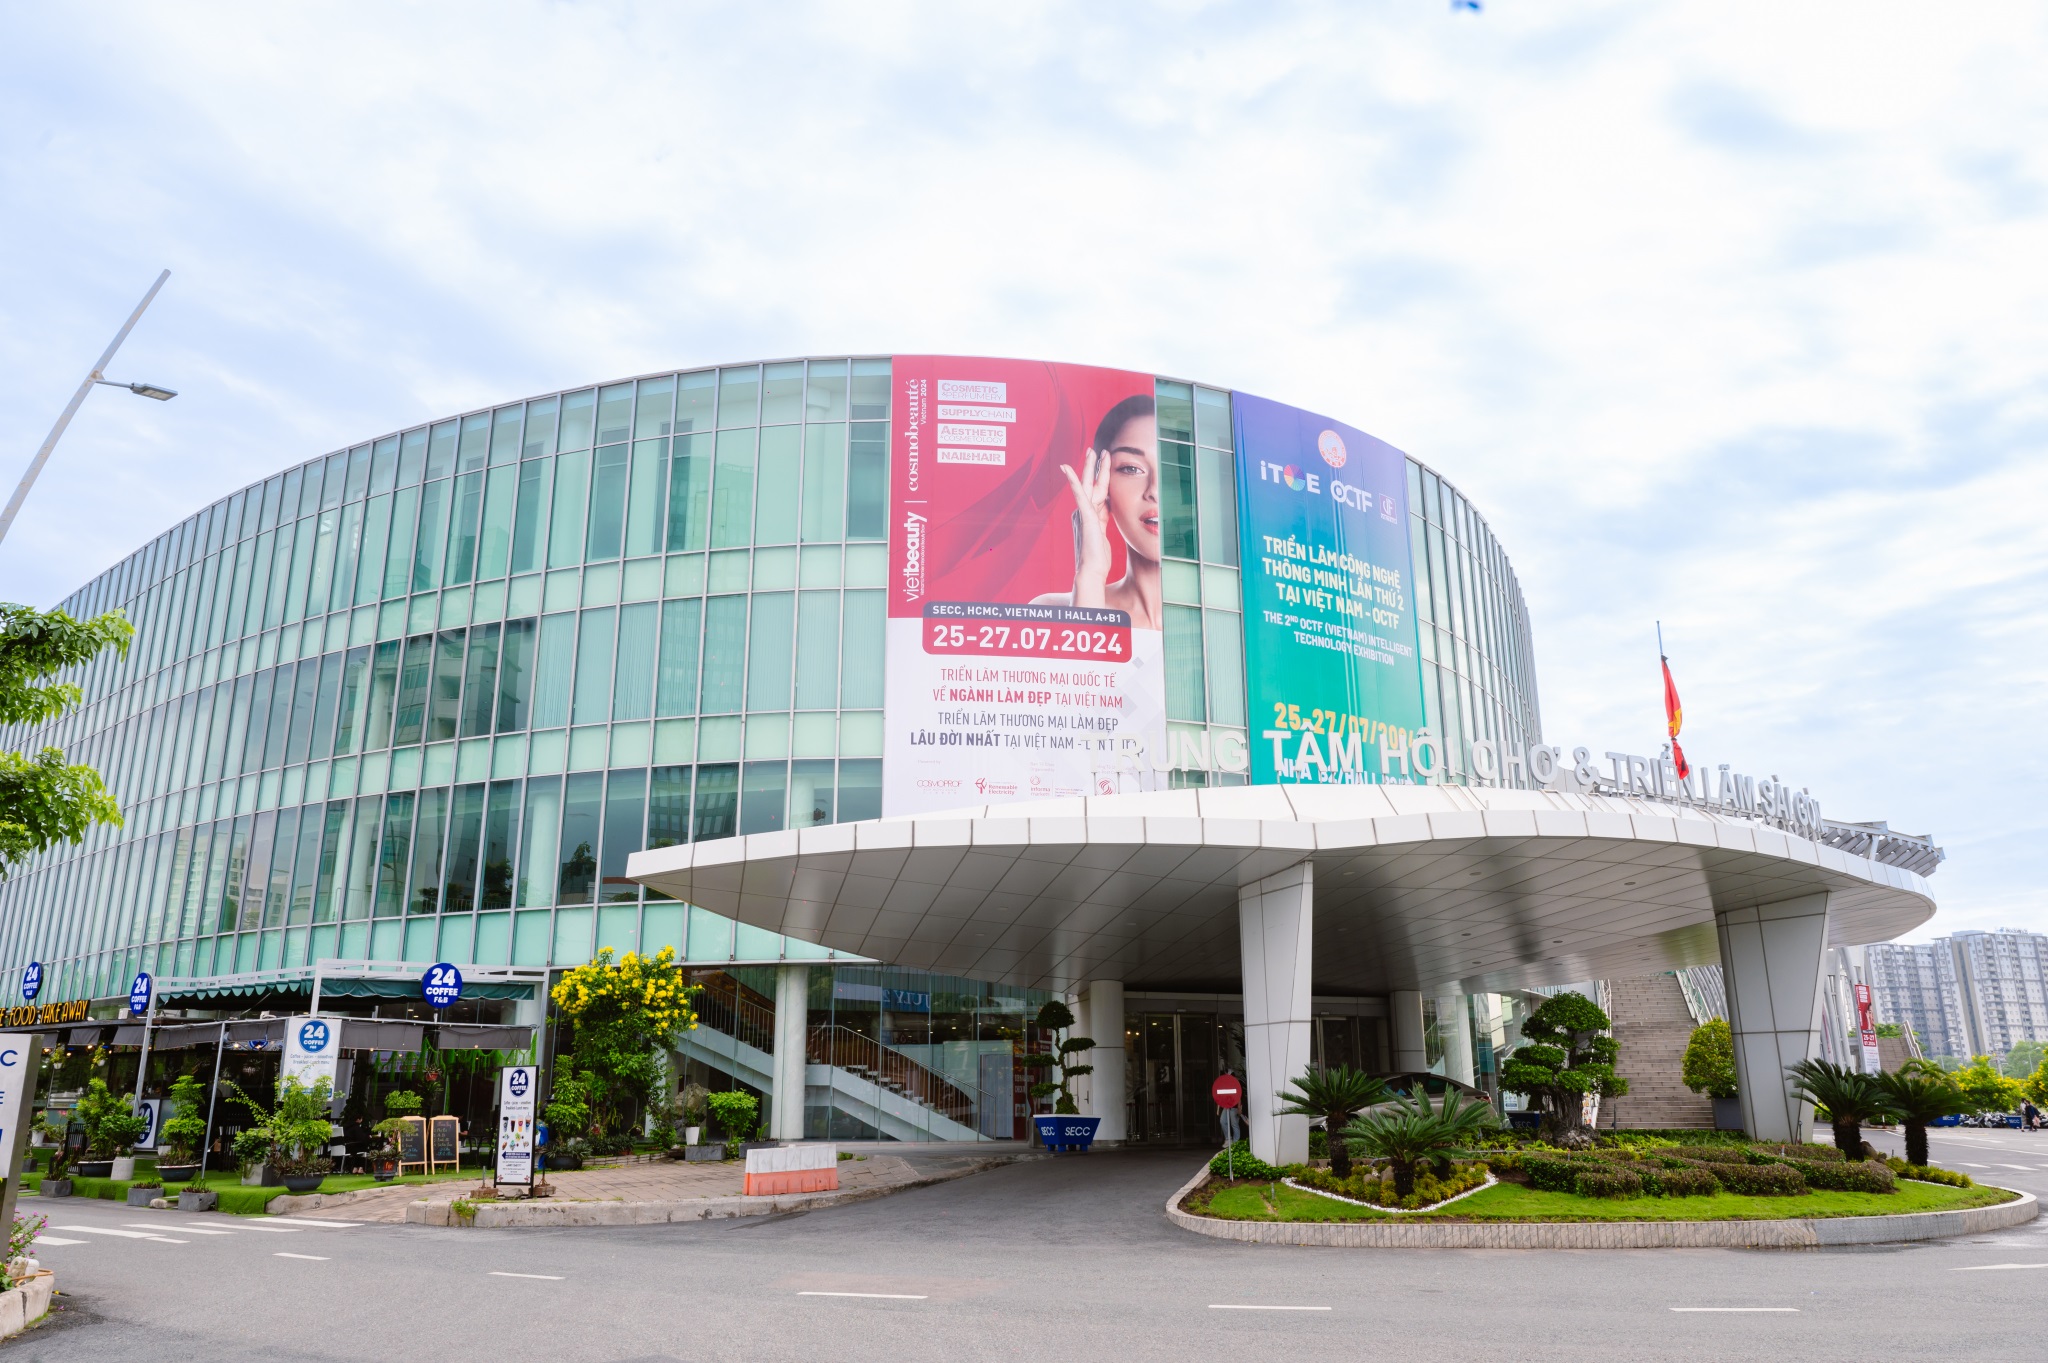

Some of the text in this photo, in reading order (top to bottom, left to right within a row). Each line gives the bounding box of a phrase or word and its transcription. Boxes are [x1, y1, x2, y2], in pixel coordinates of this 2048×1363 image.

[904, 378, 919, 491] cosmobeauté
[940, 425, 1004, 437] AESTHETIC
[903, 511, 928, 602] vietbeauty
[1263, 534, 1402, 590] TRIỂN LÃM CÔNG NGHỆ
[1262, 557, 1405, 611] THÔNG MINH LẦN THỨ 2
[932, 605, 965, 617] SECC,
[967, 606, 1002, 618] HCMC,
[1004, 608, 1052, 619] VIETNAM
[1065, 610, 1092, 622] HALL
[1095, 612, 1121, 623] A+B1
[1276, 582, 1300, 607] TẠI
[1303, 587, 1333, 613] VIỆT
[1336, 599, 1363, 618] NAM
[1372, 608, 1400, 630] OCTF
[933, 624, 1123, 655] 25-27.07.2024
[1263, 611, 1283, 625] THE
[1300, 618, 1323, 633] OCTF
[1324, 622, 1368, 645] (VIETNAM)
[1368, 635, 1412, 657] INTELLIGENT
[1293, 631, 1395, 666] TECHNOLOGY EXHIBITION
[941, 664, 1117, 688] TRIỂN LÃM THƯƠNG MẠI QUỐC TẾ
[933, 685, 1123, 709] VỀ NGÀNH LÀM ĐẸP TẠI VIỆT NAM
[938, 707, 1119, 733] TRIỂN LÃM THƯƠNG MẠI LÀM ĐẸP
[910, 729, 936, 746] LÂU
[939, 729, 964, 747] ĐỜI
[966, 728, 1000, 747] NHẤT
[1004, 734, 1022, 749] TẠI
[1024, 733, 1047, 750] VIỆT
[1050, 736, 1074, 750] NAM
[1080, 730, 1249, 772] TRUNG
[1262, 721, 1364, 773] TÂM
[1605, 742, 1698, 802] TRIỂN
[1700, 763, 1758, 813] LÃM
[1758, 774, 1793, 821] SÀI
[1792, 787, 1825, 834] GÒN
[26, 966, 39, 981] 24
[134, 977, 148, 993] 24
[430, 968, 456, 986] 24
[131, 995, 147, 1003] COFFEE
[425, 987, 459, 996] COFFEE
[434, 996, 449, 1004] F&B
[9, 1005, 36, 1026] FOOD
[41, 1001, 62, 1024] TAKE
[62, 1000, 89, 1022] AWAY
[303, 1024, 325, 1039] 24
[512, 1072, 526, 1085] 24
[1041, 1126, 1055, 1136] SECC
[1065, 1126, 1091, 1136] SECC
